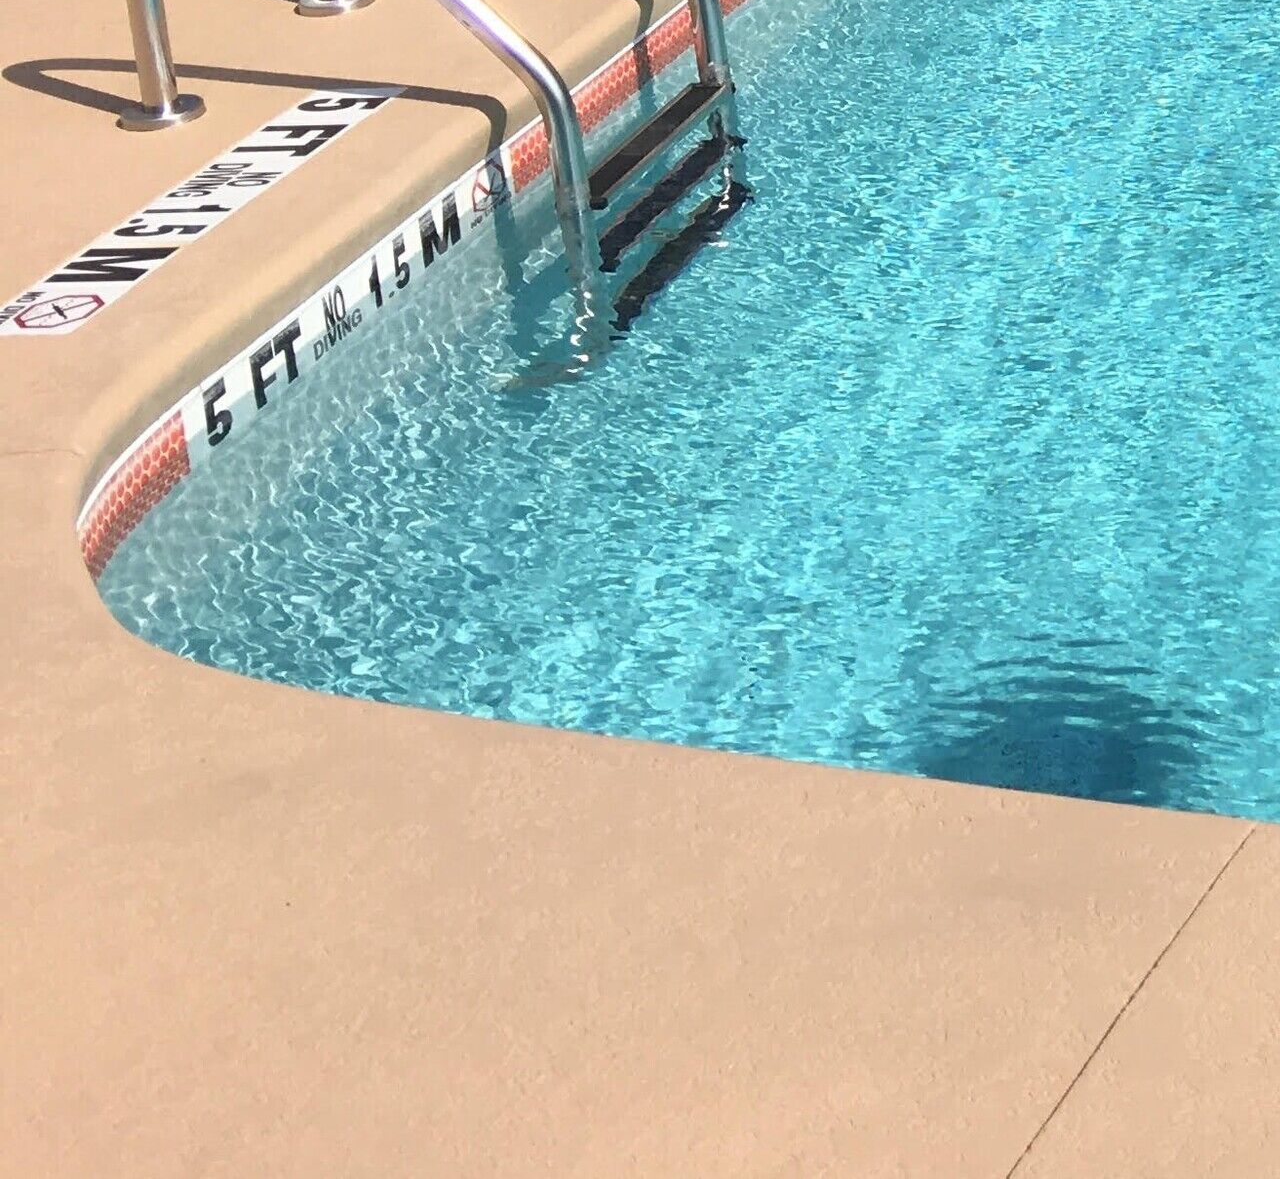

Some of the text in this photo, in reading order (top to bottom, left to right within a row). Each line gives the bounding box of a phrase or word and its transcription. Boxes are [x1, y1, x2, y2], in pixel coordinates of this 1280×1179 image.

[231, 96, 391, 158] 5 FT
[165, 162, 253, 198] DIVING
[226, 171, 282, 188] NO
[44, 204, 232, 283] 1.5 M
[368, 190, 462, 309] 1.5 M
[313, 308, 363, 361] DIVING
[322, 284, 347, 332] NO
[202, 317, 301, 447] 5 FT
